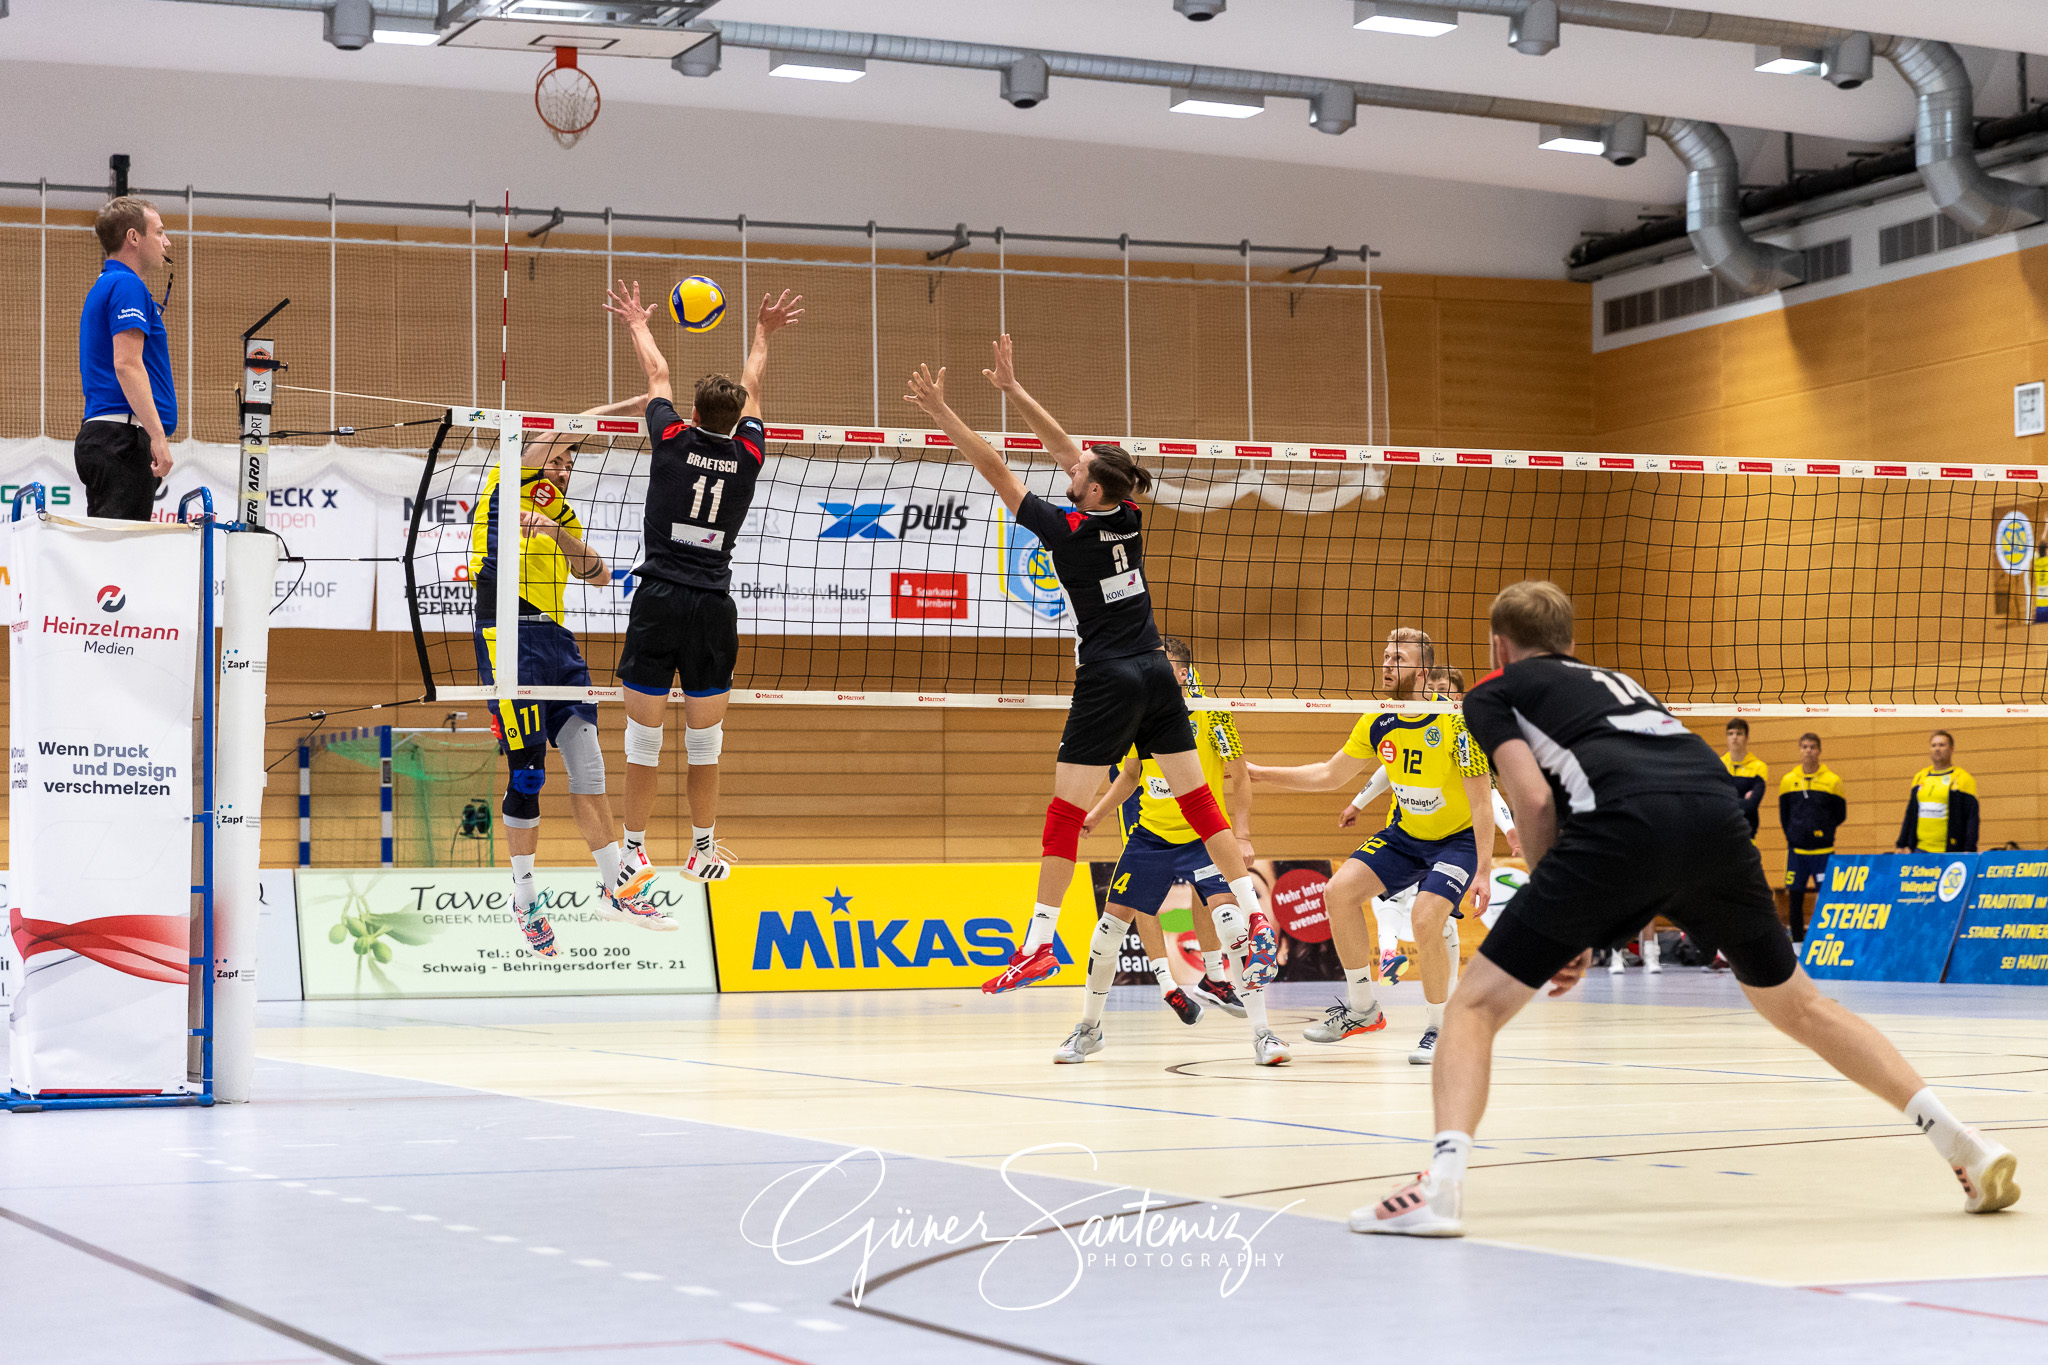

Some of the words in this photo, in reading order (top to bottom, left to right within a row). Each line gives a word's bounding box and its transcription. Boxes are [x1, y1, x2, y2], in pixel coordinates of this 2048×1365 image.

[251, 416, 262, 445] PORT
[687, 452, 738, 474] BRAETSCH
[266, 488, 313, 507] ECK
[690, 475, 725, 523] 11
[404, 497, 479, 523] MEY
[899, 496, 969, 539] puls
[265, 513, 315, 532] mpen
[403, 527, 439, 539] Duck
[916, 588, 958, 599] Sparkasse
[916, 599, 957, 611] Nürnberg
[43, 616, 179, 640] Heinzelmann
[84, 640, 134, 655] Medien
[227, 660, 249, 669] Zapf
[520, 704, 541, 735] 11
[38, 741, 89, 757] Wenn
[93, 743, 149, 758] Druck
[1403, 748, 1423, 774] 12
[72, 761, 108, 776] und
[112, 761, 177, 782] Design
[43, 780, 170, 796] verschmelzen
[221, 815, 244, 825] Zapf
[1831, 866, 1869, 892] WIR
[2015, 862, 2048, 878] EMOTI
[1113, 872, 1132, 895] 4
[1274, 889, 1302, 906] Mehr
[1301, 881, 1326, 898] Infos
[1978, 894, 2036, 909] TRADITION
[1294, 896, 1321, 914] unter
[422, 914, 473, 924] GREEK
[1289, 909, 1329, 931] avenon.
[1817, 903, 1892, 930] STEHEN
[477, 948, 510, 959] Tel.:
[570, 947, 599, 958] 500
[603, 947, 630, 958] 200
[216, 970, 239, 979] Zapf
[422, 962, 486, 976] Schwaig
[502, 960, 633, 974] Behringersdorfer
[636, 960, 664, 971] Str.
[668, 959, 686, 970] 21
